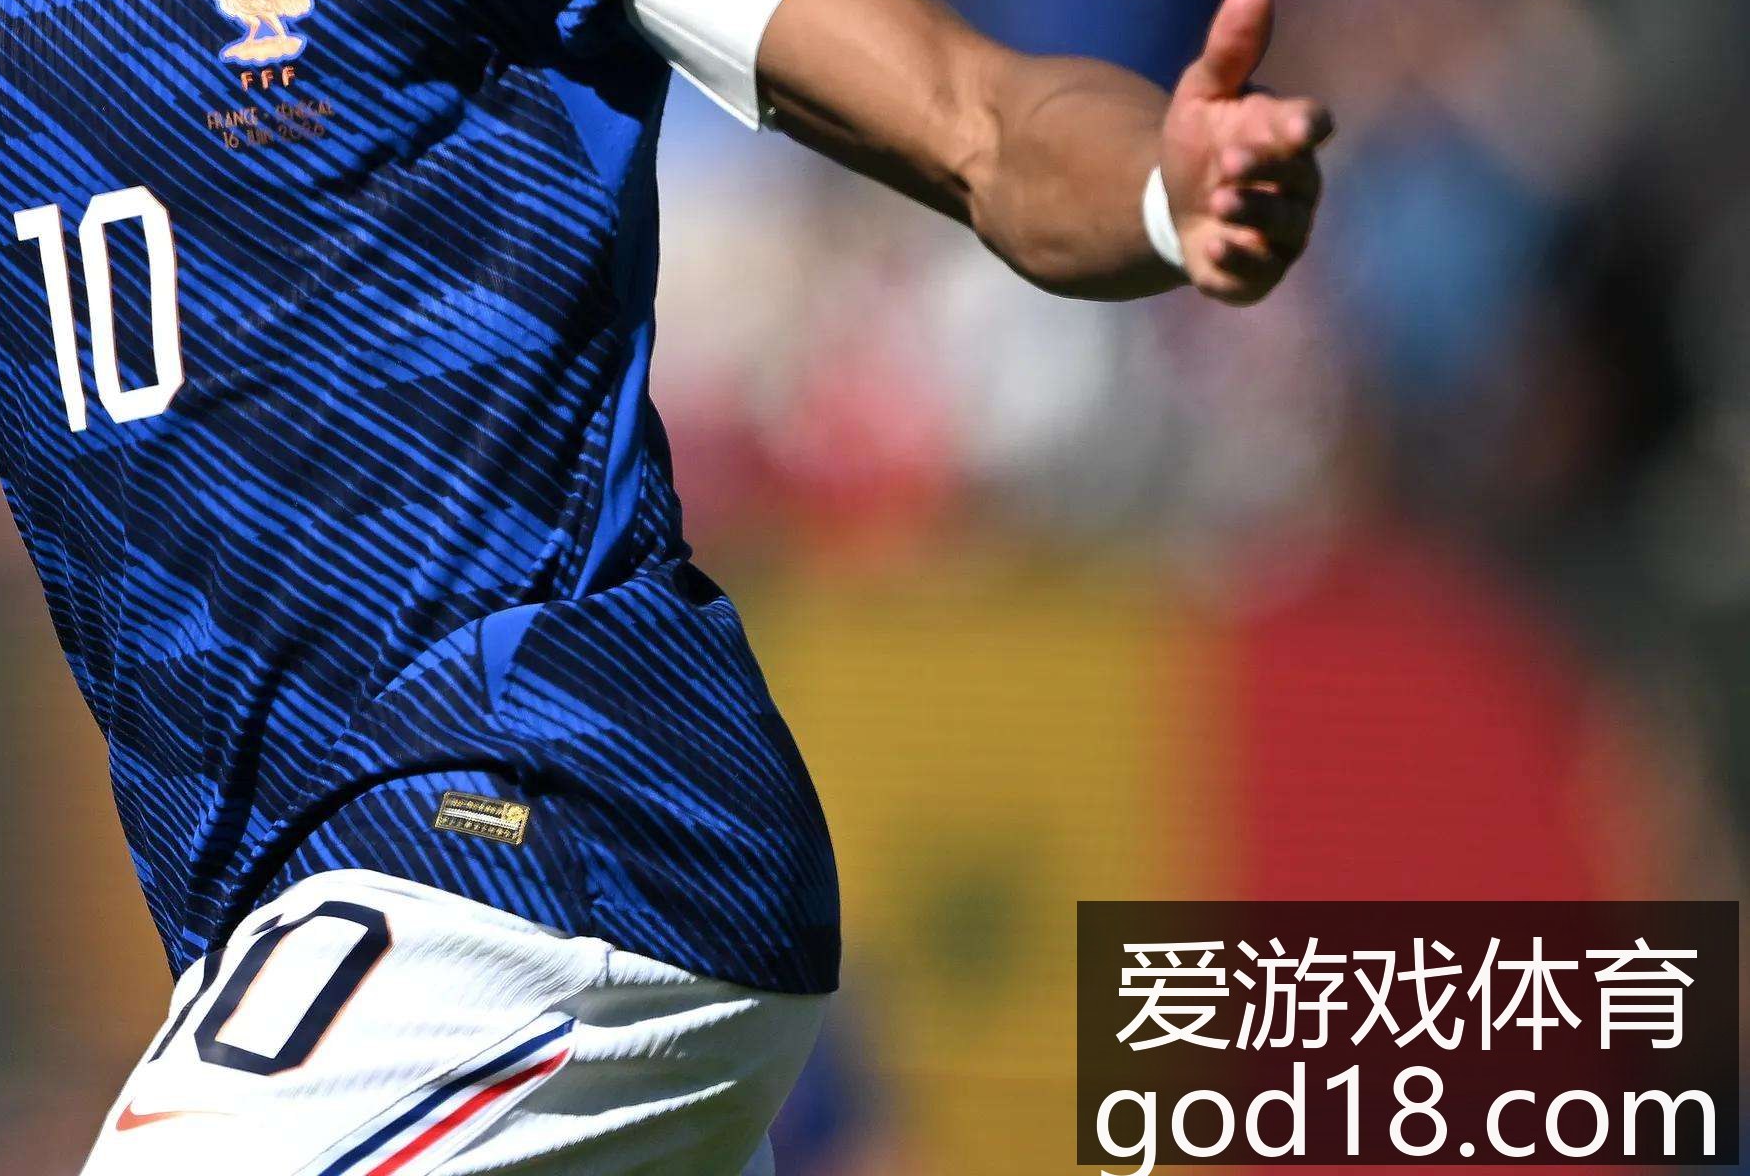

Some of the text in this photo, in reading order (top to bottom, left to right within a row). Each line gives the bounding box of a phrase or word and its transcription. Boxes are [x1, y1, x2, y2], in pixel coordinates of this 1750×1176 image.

[207, 106, 259, 130] FRANCE
[223, 126, 240, 149] 16
[13, 185, 185, 433] 10
[148, 901, 396, 1077] 10
